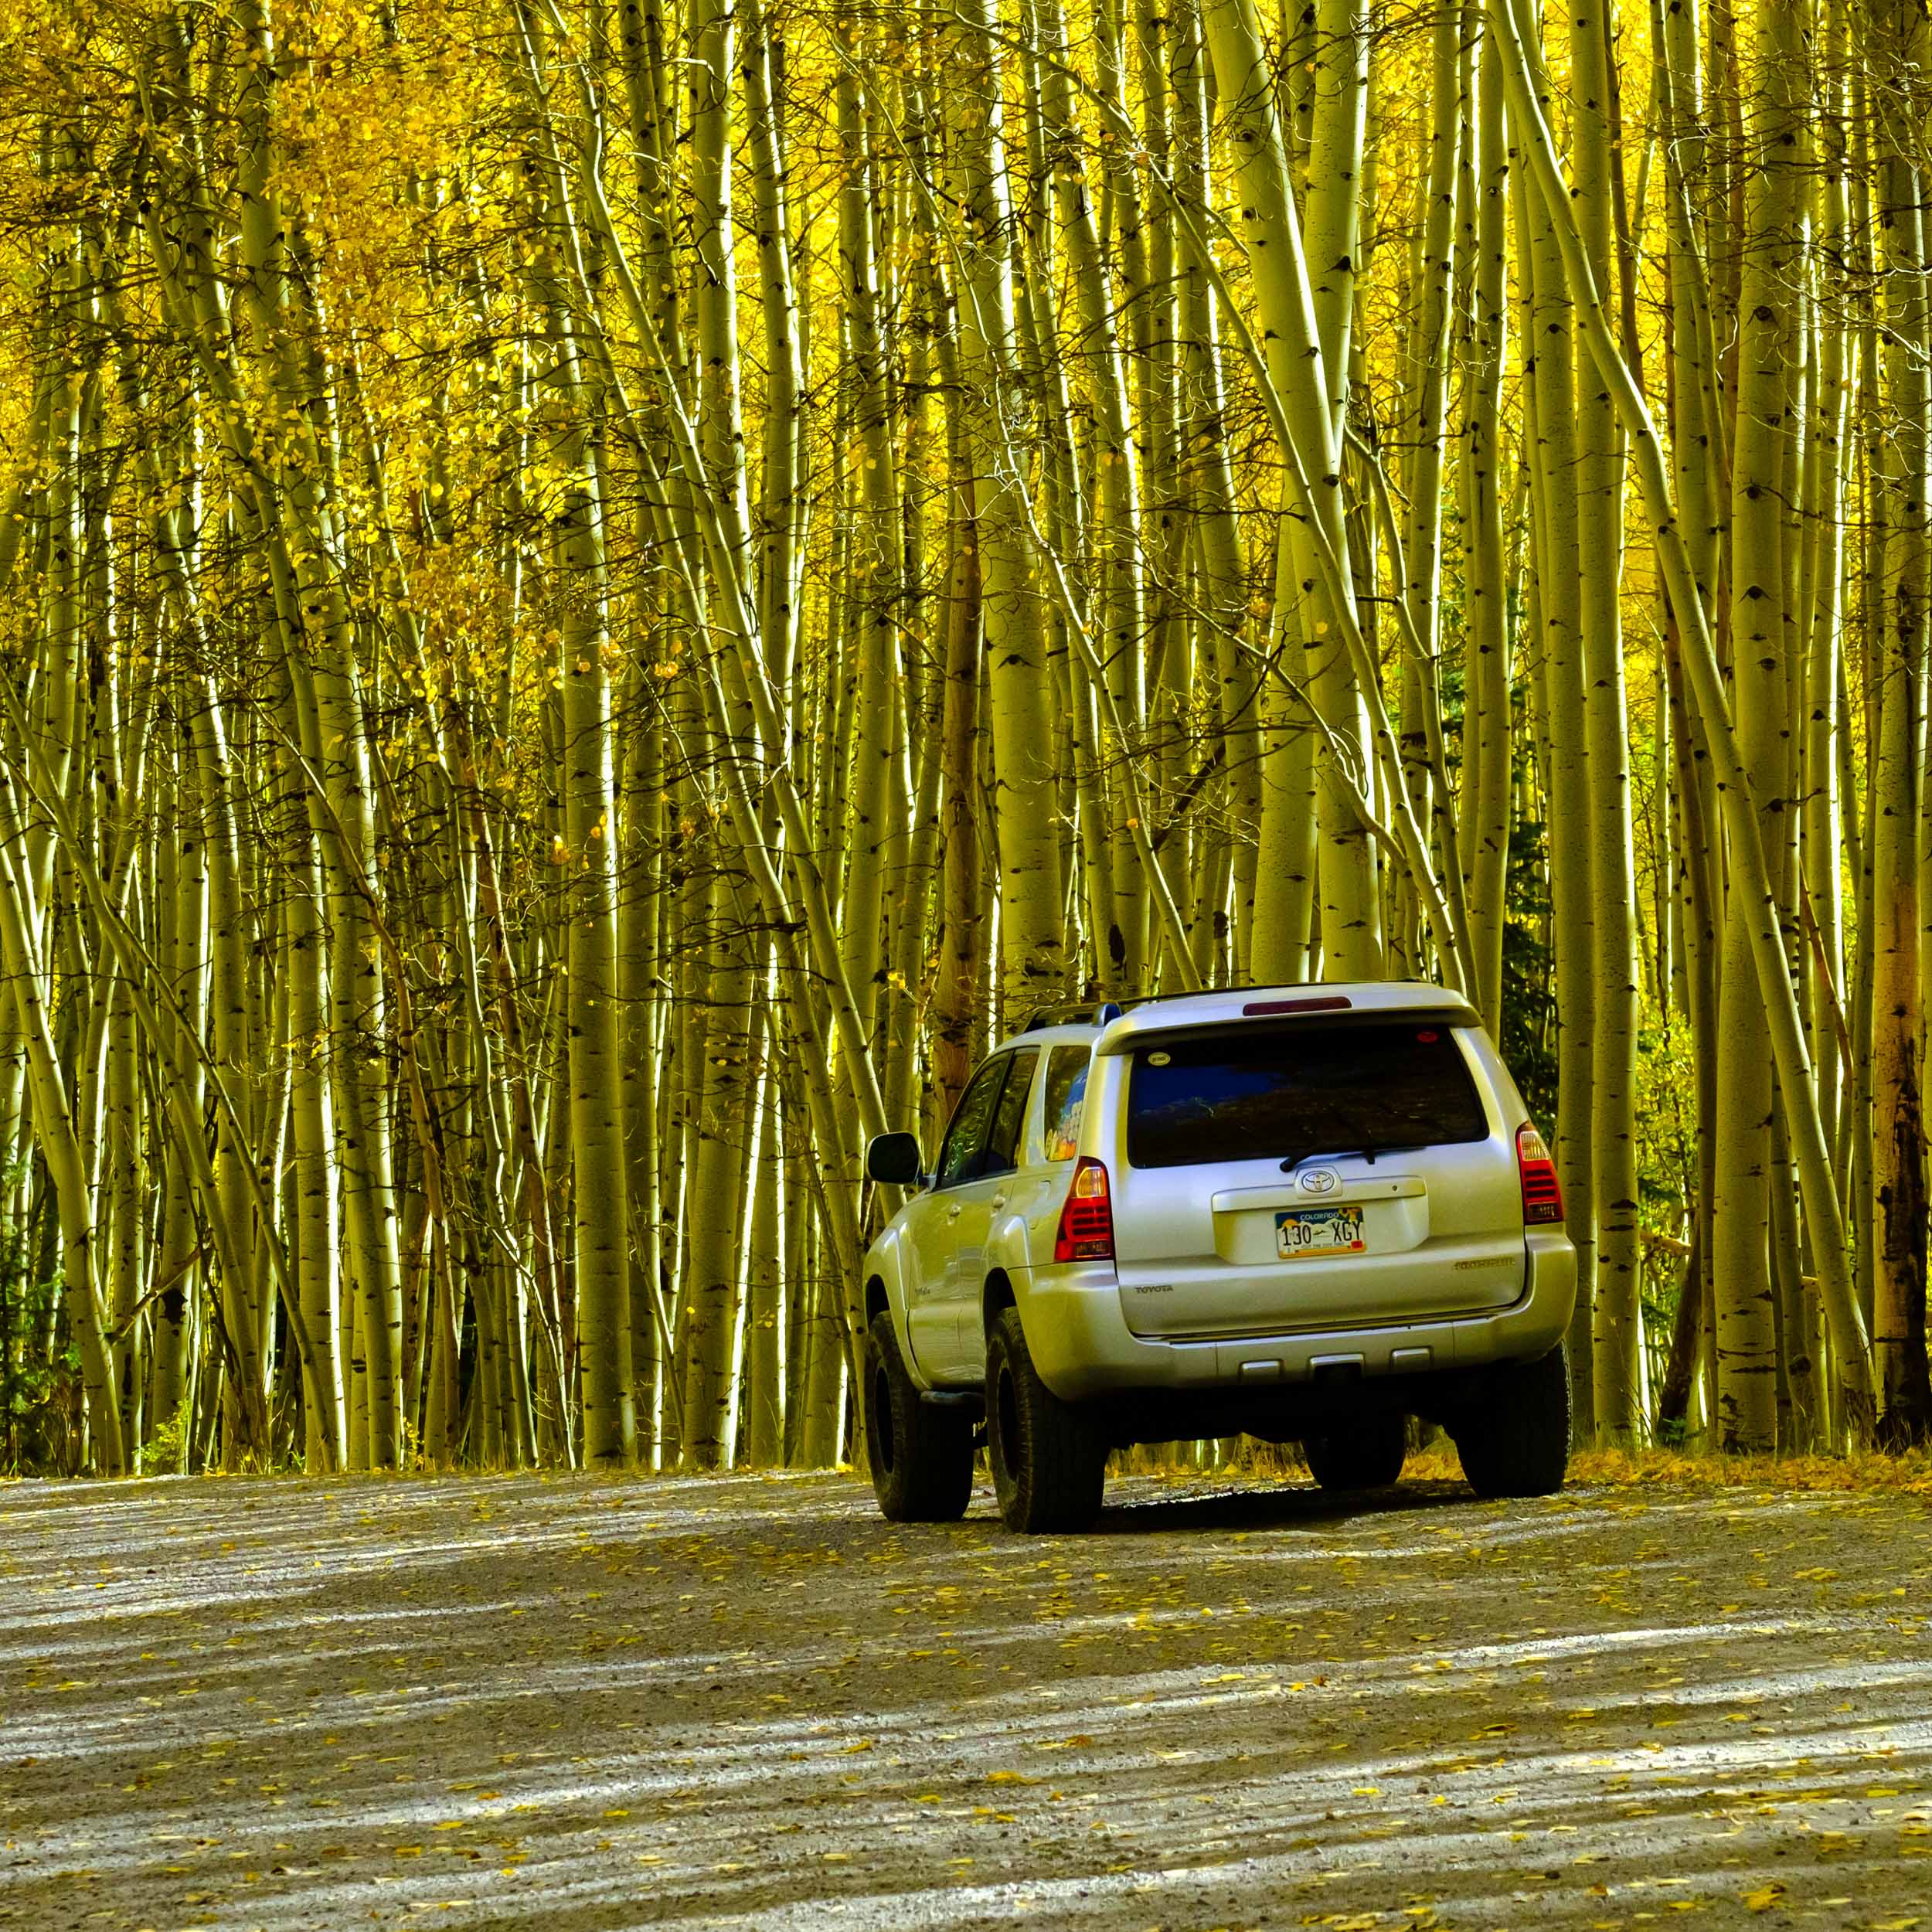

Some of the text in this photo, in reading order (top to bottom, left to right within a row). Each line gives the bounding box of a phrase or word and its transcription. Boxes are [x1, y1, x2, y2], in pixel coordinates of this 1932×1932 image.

[1300, 1212, 1339, 1221] COLORADO
[1282, 1220, 1360, 1246] 130 XGY
[1134, 1284, 1174, 1294] TOYOTA
